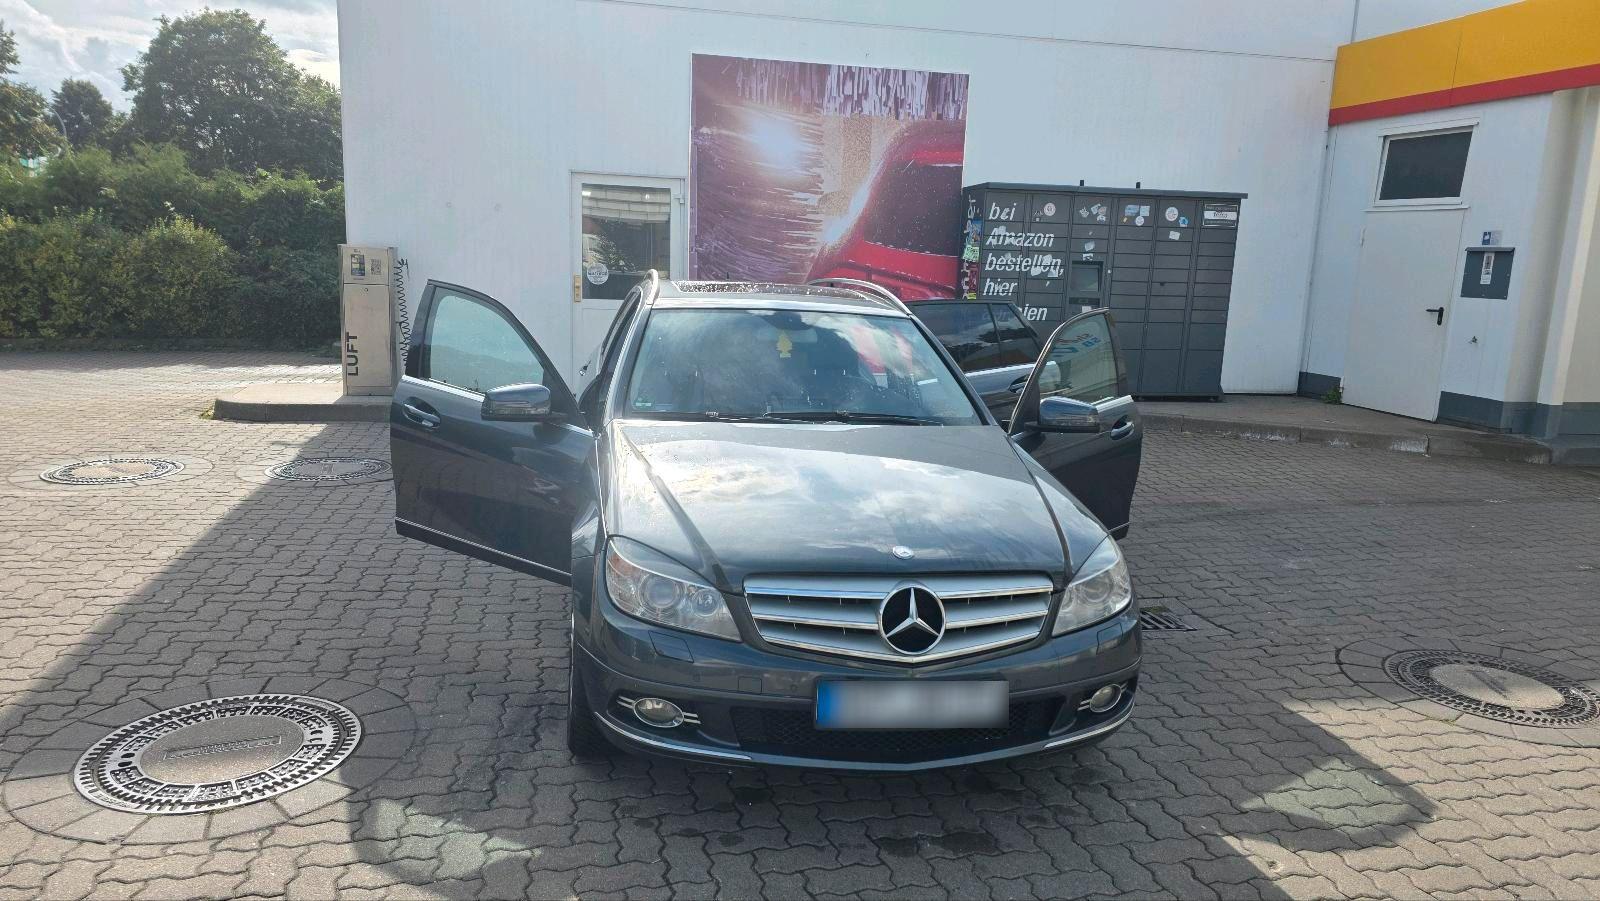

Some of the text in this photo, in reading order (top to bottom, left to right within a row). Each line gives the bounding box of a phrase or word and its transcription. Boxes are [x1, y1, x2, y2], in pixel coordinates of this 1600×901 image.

[988, 202, 1017, 220] bei
[985, 226, 1055, 247] Amazon
[984, 253, 1065, 276] bestellen,
[982, 278, 1018, 296] hier
[346, 331, 359, 376] LUFT
